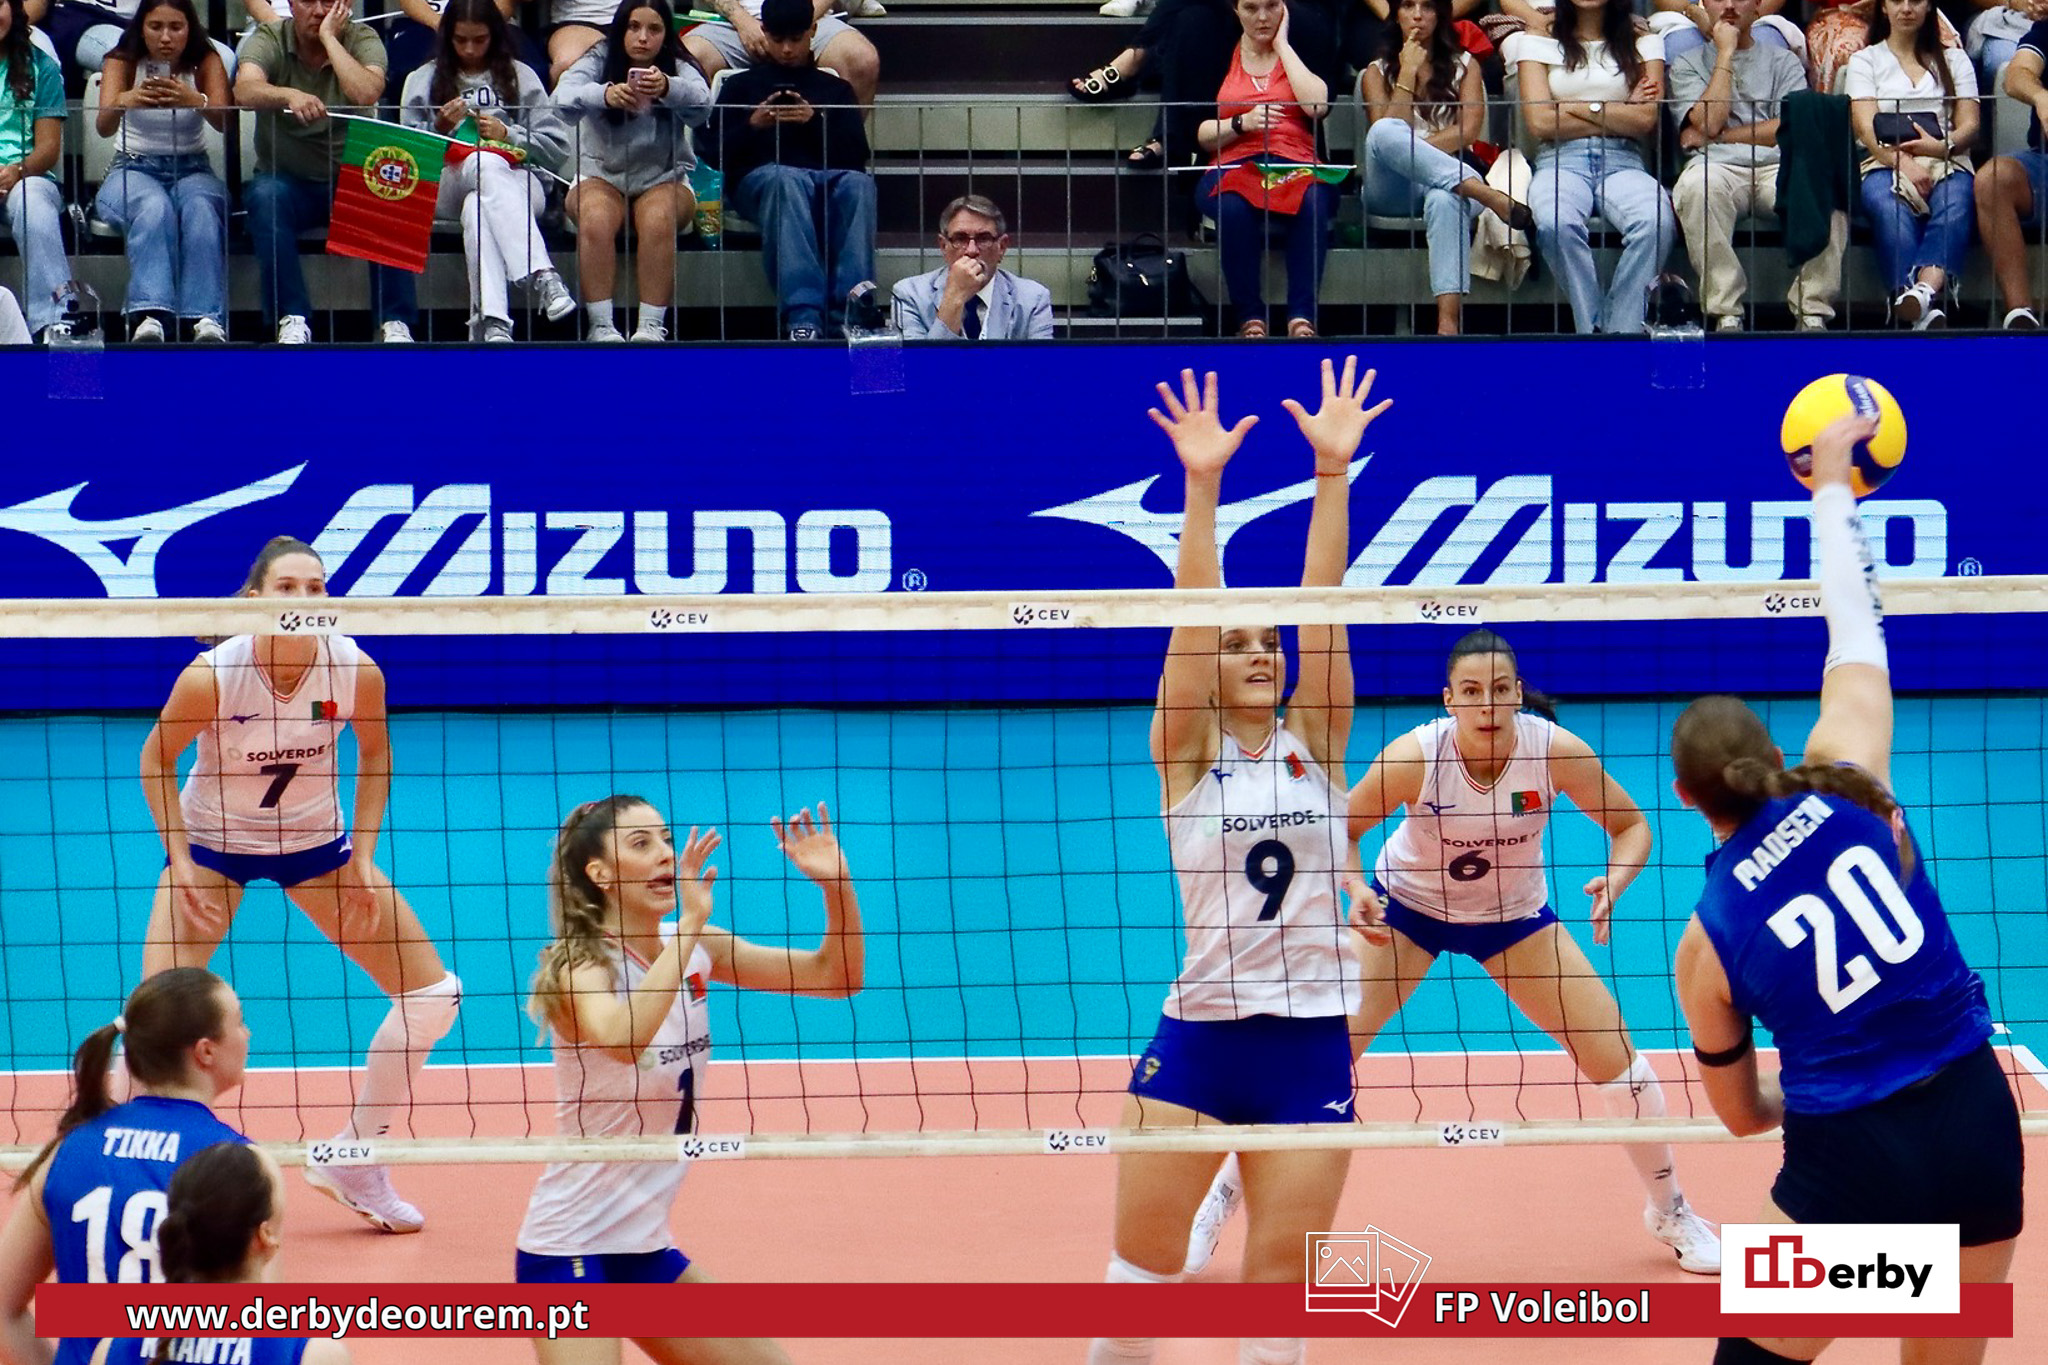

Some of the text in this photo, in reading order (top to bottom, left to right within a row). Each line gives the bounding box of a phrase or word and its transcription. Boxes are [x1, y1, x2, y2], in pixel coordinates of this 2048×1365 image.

[311, 484, 892, 596] MIZUNO
[1341, 474, 1947, 586] MIZUNO
[1446, 605, 1478, 617] CEV
[1790, 597, 1821, 608] CEV
[305, 615, 338, 627] CEV
[675, 613, 709, 625] CEV
[1037, 609, 1070, 620] CEV
[246, 745, 325, 762] SOLVERDE
[259, 763, 303, 808] 7
[1222, 810, 1317, 833] SOLVERDE
[1441, 834, 1528, 848] SOLVERDE
[1732, 794, 1834, 892] MADSEN
[1448, 850, 1491, 882] 6
[1245, 839, 1295, 922] 9
[1766, 845, 1925, 1014] 20
[674, 1068, 695, 1135] 1
[1074, 1135, 1106, 1147] CEV
[1468, 1129, 1500, 1140] CEV
[102, 1127, 180, 1163] TIKKA
[338, 1147, 370, 1158] CEV
[708, 1141, 741, 1153] CEV
[71, 1185, 169, 1283] 18
